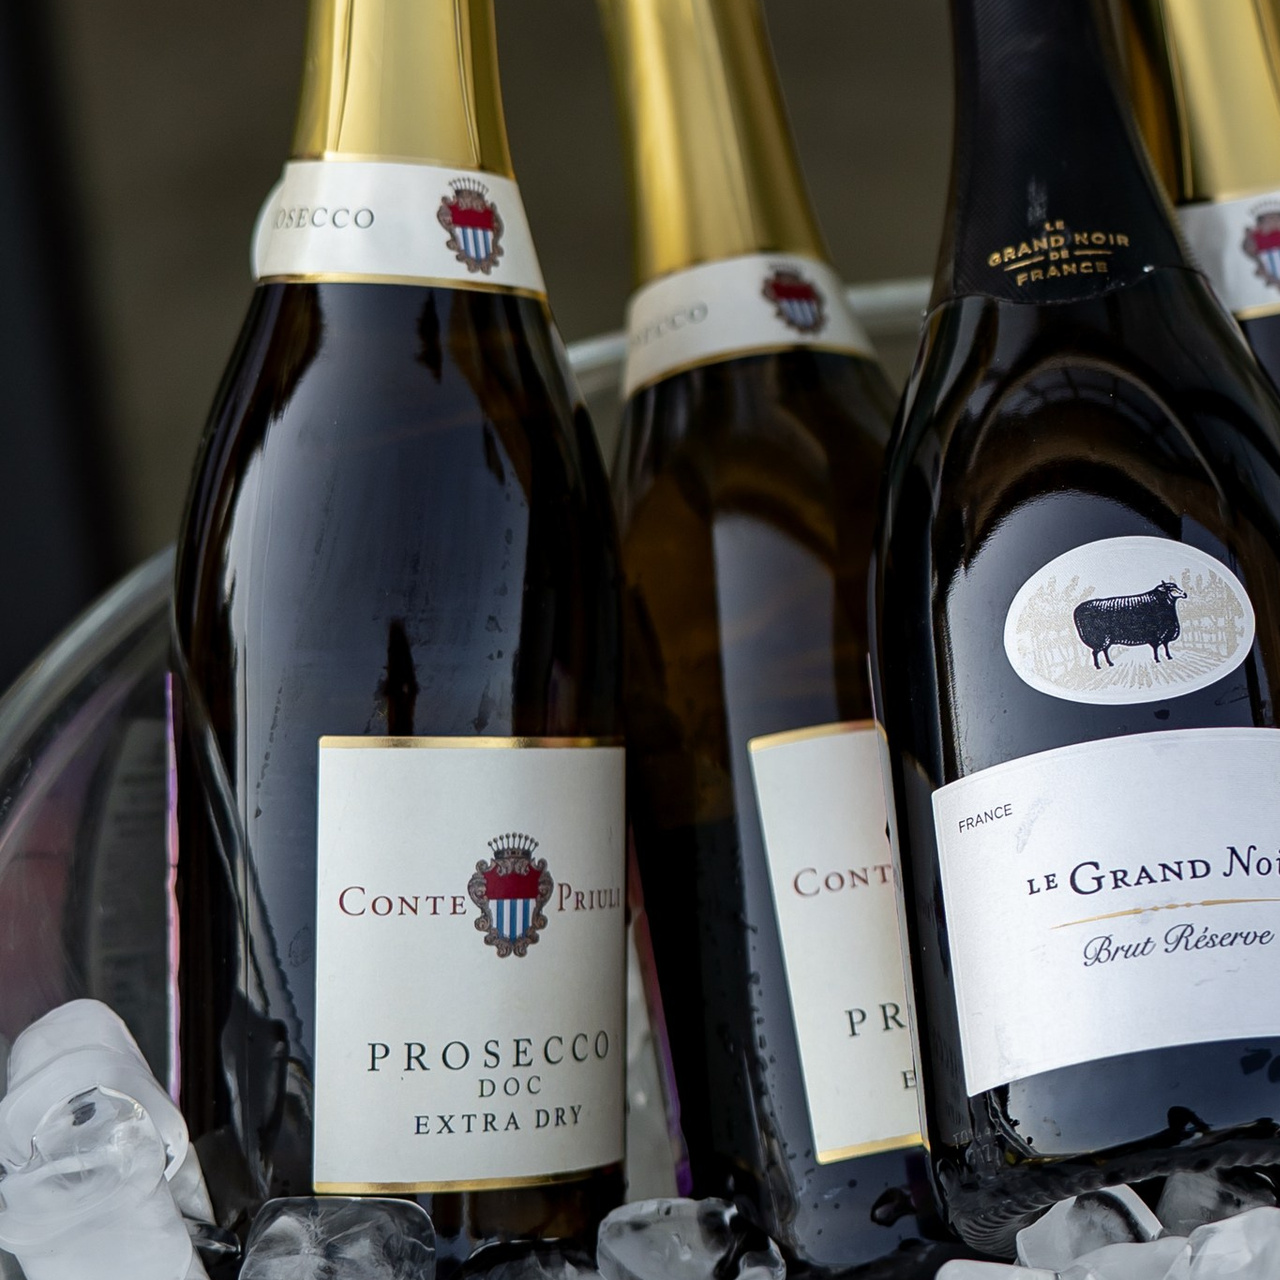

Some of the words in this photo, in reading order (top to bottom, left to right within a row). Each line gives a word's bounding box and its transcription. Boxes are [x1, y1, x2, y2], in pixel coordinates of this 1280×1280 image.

[272, 207, 375, 230] OSECCO
[1044, 219, 1066, 232] LE
[987, 233, 1067, 268] GRAND
[1074, 232, 1130, 247] NOIR
[1049, 249, 1071, 261] DE
[1015, 261, 1108, 287] FRANCE
[958, 803, 1014, 834] FRANCE
[1026, 873, 1059, 896] LE
[1069, 858, 1212, 896] GRAND
[338, 885, 468, 917] CONTE
[557, 882, 621, 912] PRIULI
[1083, 934, 1157, 967] Brut
[1163, 922, 1276, 954] Réserve
[367, 1029, 610, 1072] PROSECCO
[478, 1075, 542, 1098] DOC
[413, 1111, 521, 1135] EXTRA
[535, 1104, 583, 1129] DRY
